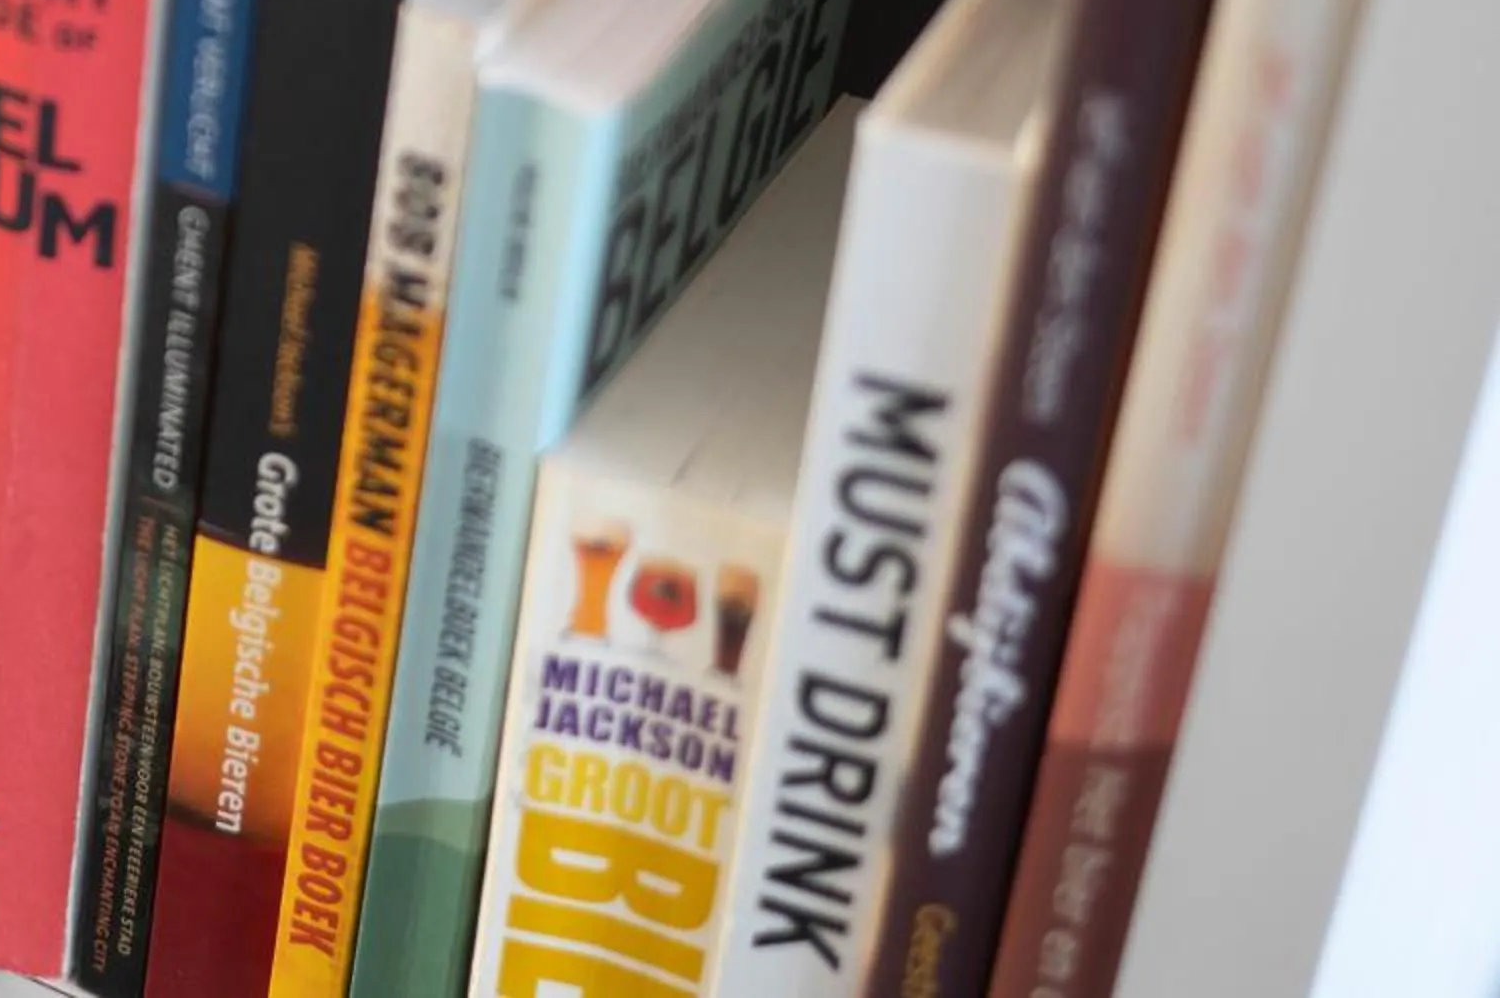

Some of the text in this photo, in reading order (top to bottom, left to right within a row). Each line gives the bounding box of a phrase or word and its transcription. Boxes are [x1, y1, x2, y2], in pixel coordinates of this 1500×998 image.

[152, 204, 211, 491] GHENT ILLUMINATED
[345, 259, 430, 540] MAGERMAN
[246, 450, 299, 557] Grote
[229, 557, 282, 721] Belgische
[318, 537, 395, 743] BELGISCH
[751, 373, 952, 973] MUST DRINK
[532, 698, 739, 786] JACKSON
[540, 652, 741, 742] MICHAEL
[110, 737, 132, 790] STONE
[135, 757, 153, 800] VOOR
[215, 721, 260, 835] Bieren
[305, 736, 365, 847] BIER
[521, 741, 732, 853] GROOT
[96, 836, 121, 942] ENCHANTING
[117, 916, 137, 955] STAD
[287, 838, 348, 956] BOEK
[91, 941, 109, 973] CITY
